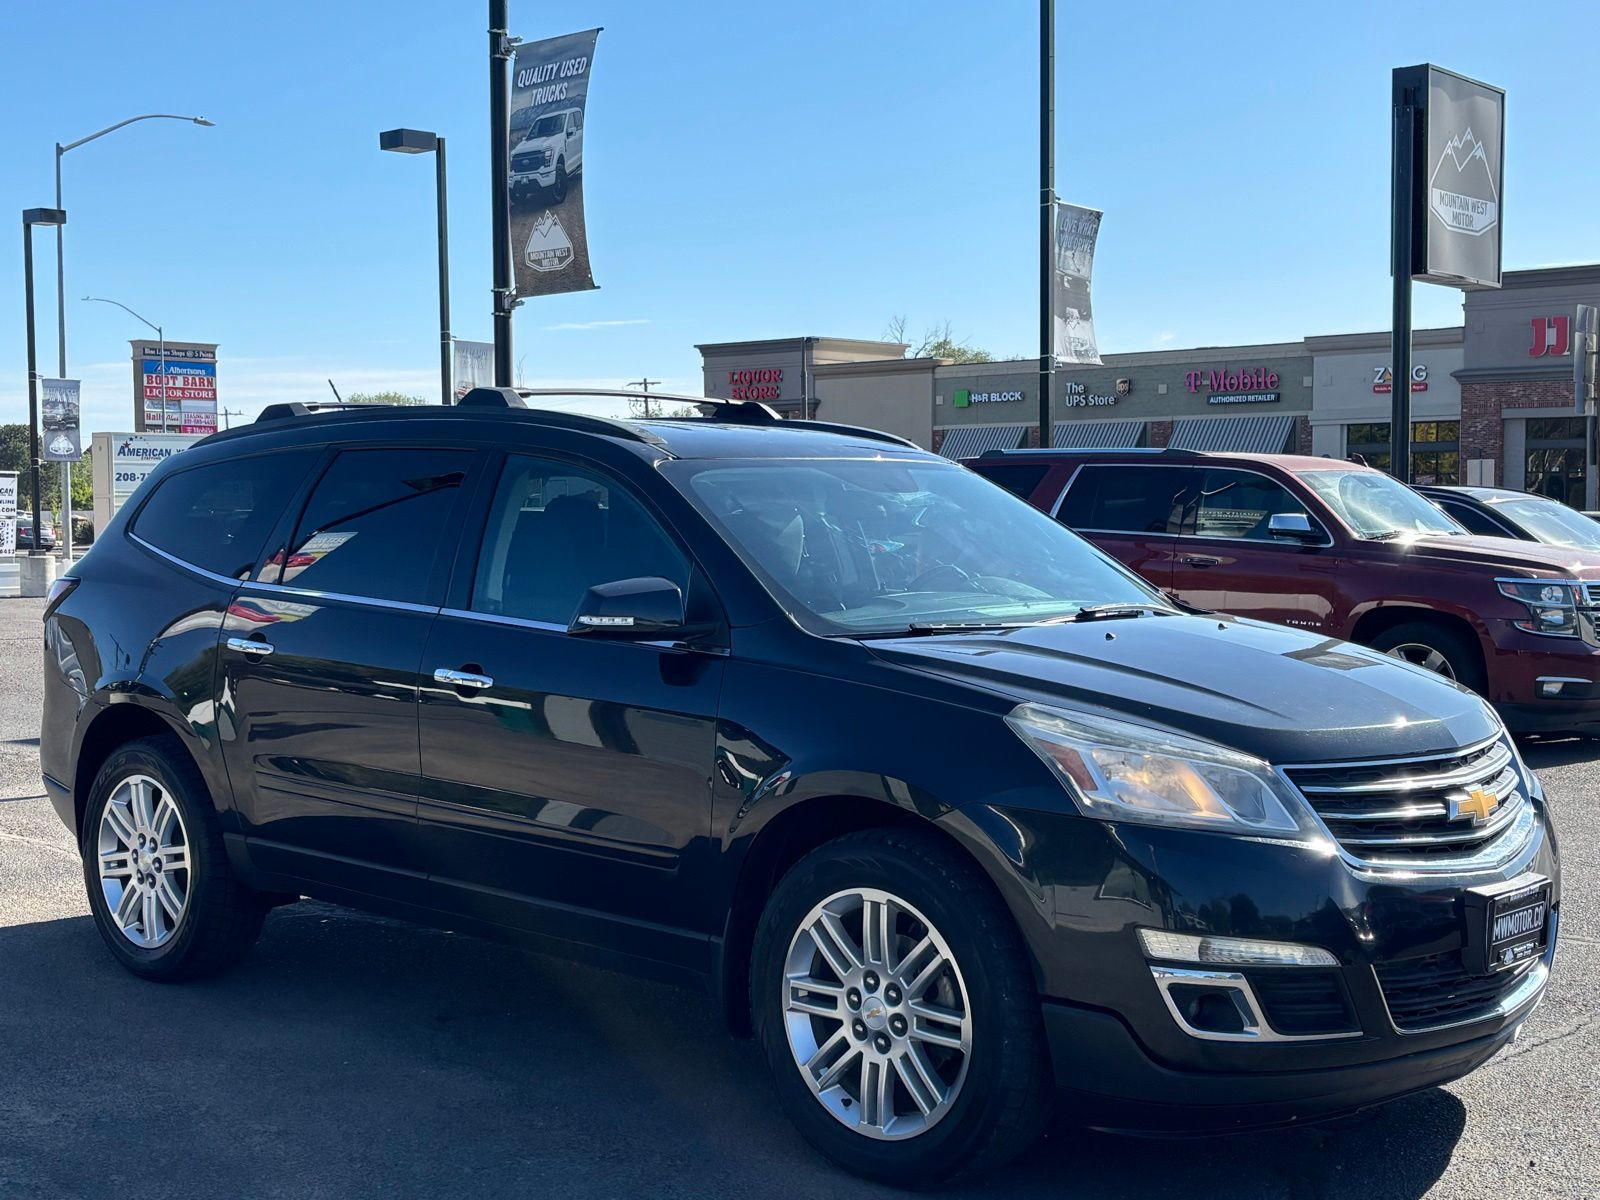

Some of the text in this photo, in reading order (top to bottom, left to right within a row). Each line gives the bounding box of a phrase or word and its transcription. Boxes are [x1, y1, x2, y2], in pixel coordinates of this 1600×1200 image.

[517, 57, 587, 88] QUALITY USED
[531, 82, 568, 106] TRUCKS
[1440, 191, 1488, 216] MOUNTAIN WEST
[1452, 210, 1474, 228] MOTOR
[1060, 216, 1096, 237] LOVE WHAT
[530, 247, 568, 260] MOUNTAIN WEST
[169, 366, 206, 376] Albertsons
[728, 368, 781, 385] LIQUOR
[146, 375, 214, 388] BOOT BARN
[1066, 382, 1085, 394] The
[184, 389, 215, 399] STORE
[732, 386, 779, 400] STORE
[971, 391, 1022, 403] H&R BLOCK
[1209, 393, 1276, 403] AUTHORIZED RETAILER
[1066, 394, 1115, 407] UPS Store
[117, 446, 172, 457] AMERICAN
[115, 472, 151, 482] 208-7
